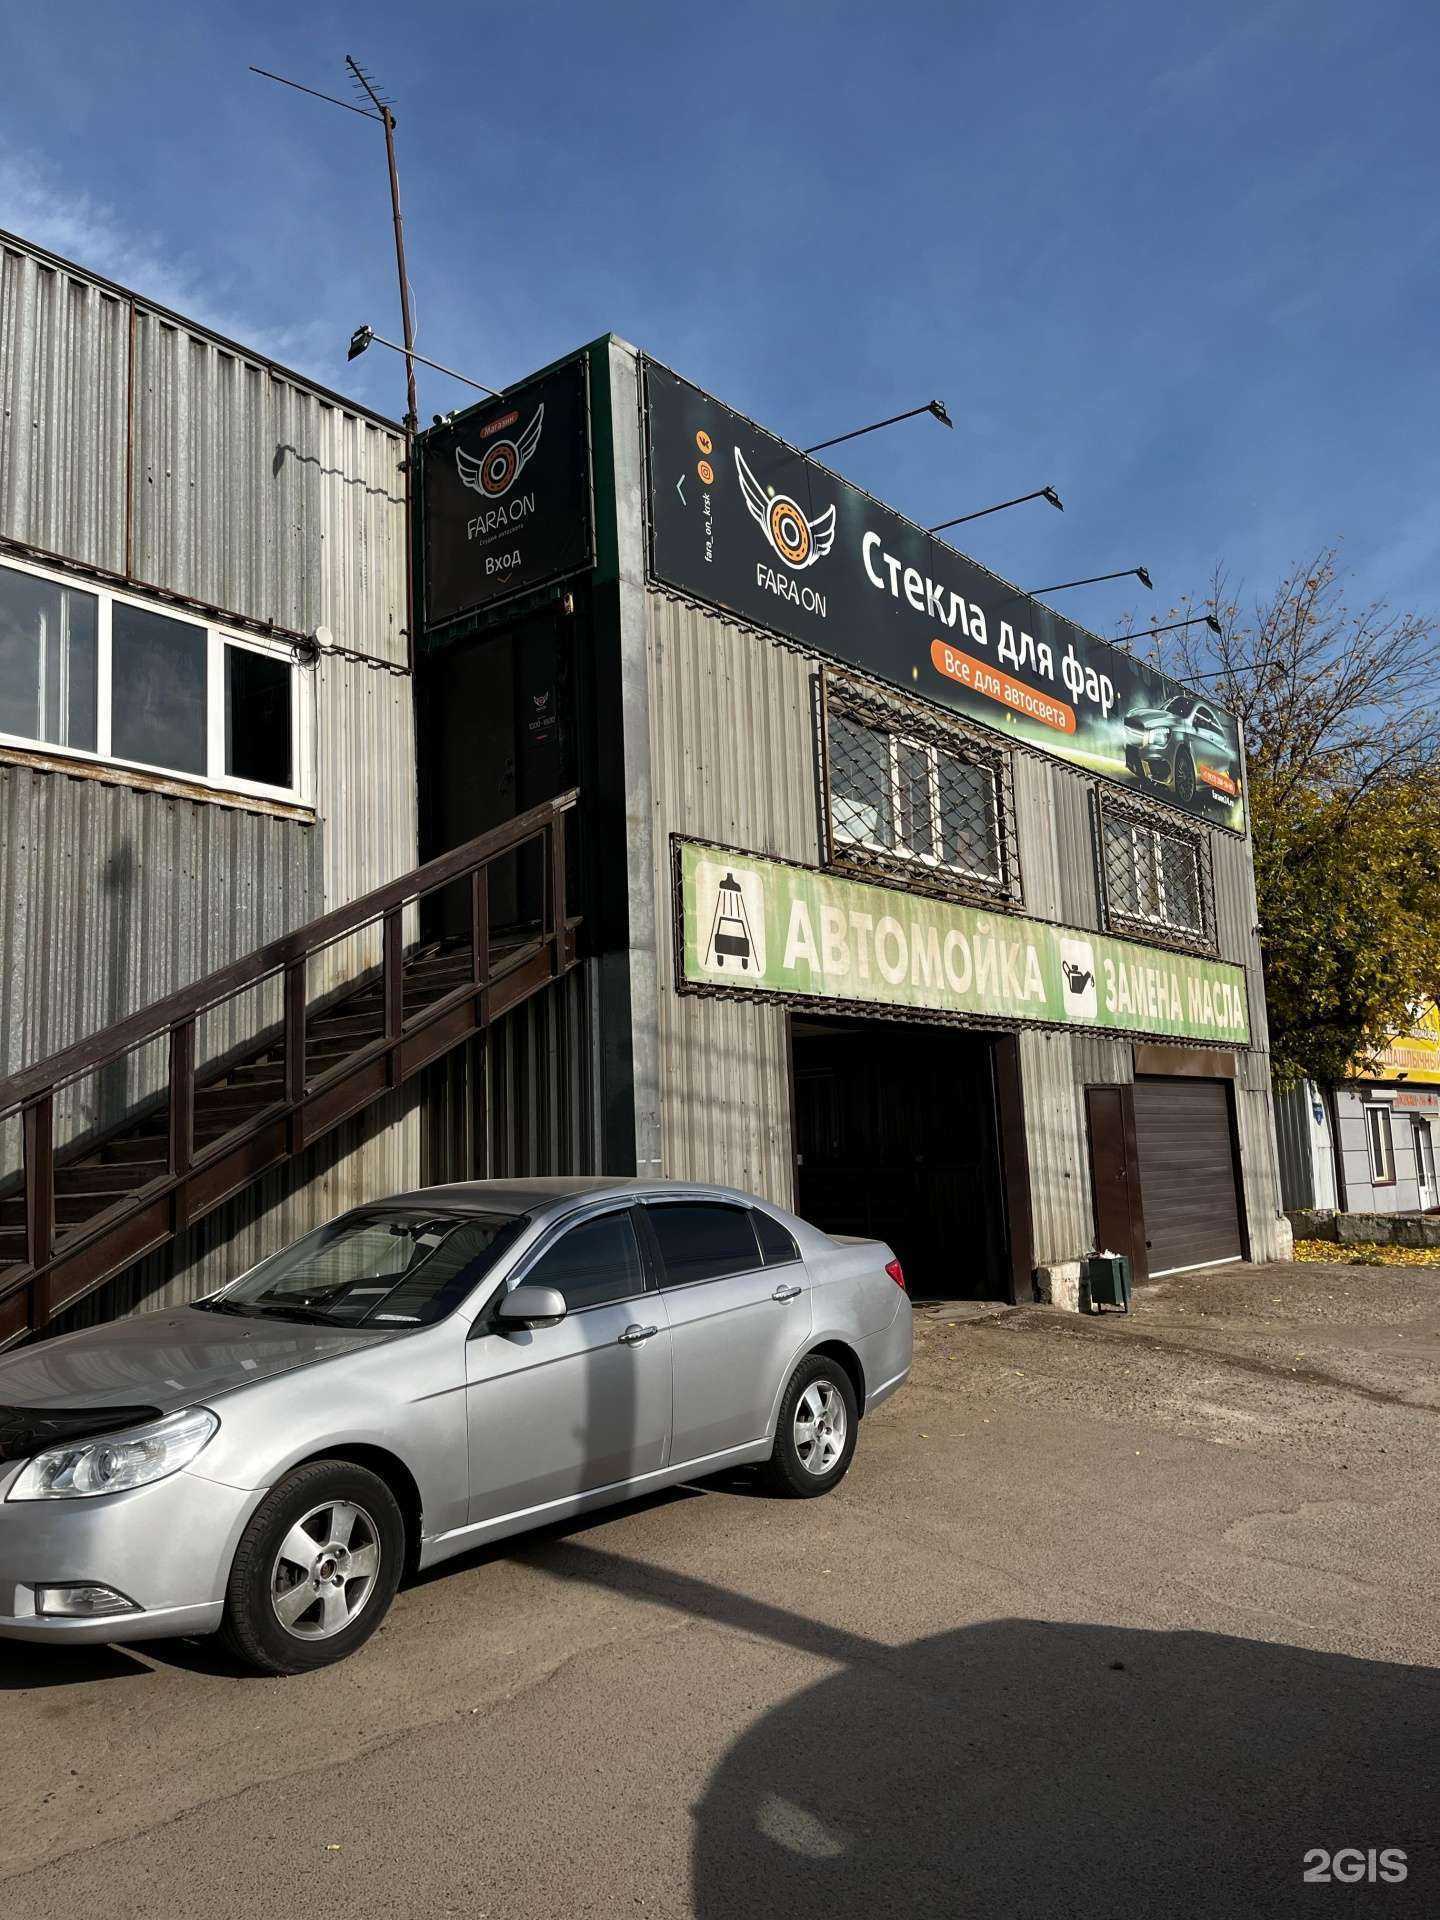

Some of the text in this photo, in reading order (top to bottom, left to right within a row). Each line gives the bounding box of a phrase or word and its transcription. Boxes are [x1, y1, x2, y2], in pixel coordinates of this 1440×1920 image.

[467, 492, 536, 540] FARA ON
[703, 493, 713, 563] fara_on_krsk
[485, 549, 522, 576] Вход
[757, 563, 827, 618] FARA ON
[862, 531, 1114, 718] Стекла для фар
[944, 649, 1067, 729] Все для автосвета
[782, 899, 1048, 1003] АВТОМОЙКА
[1103, 958, 1245, 1029] ЗАМЕНА МАСЛА
